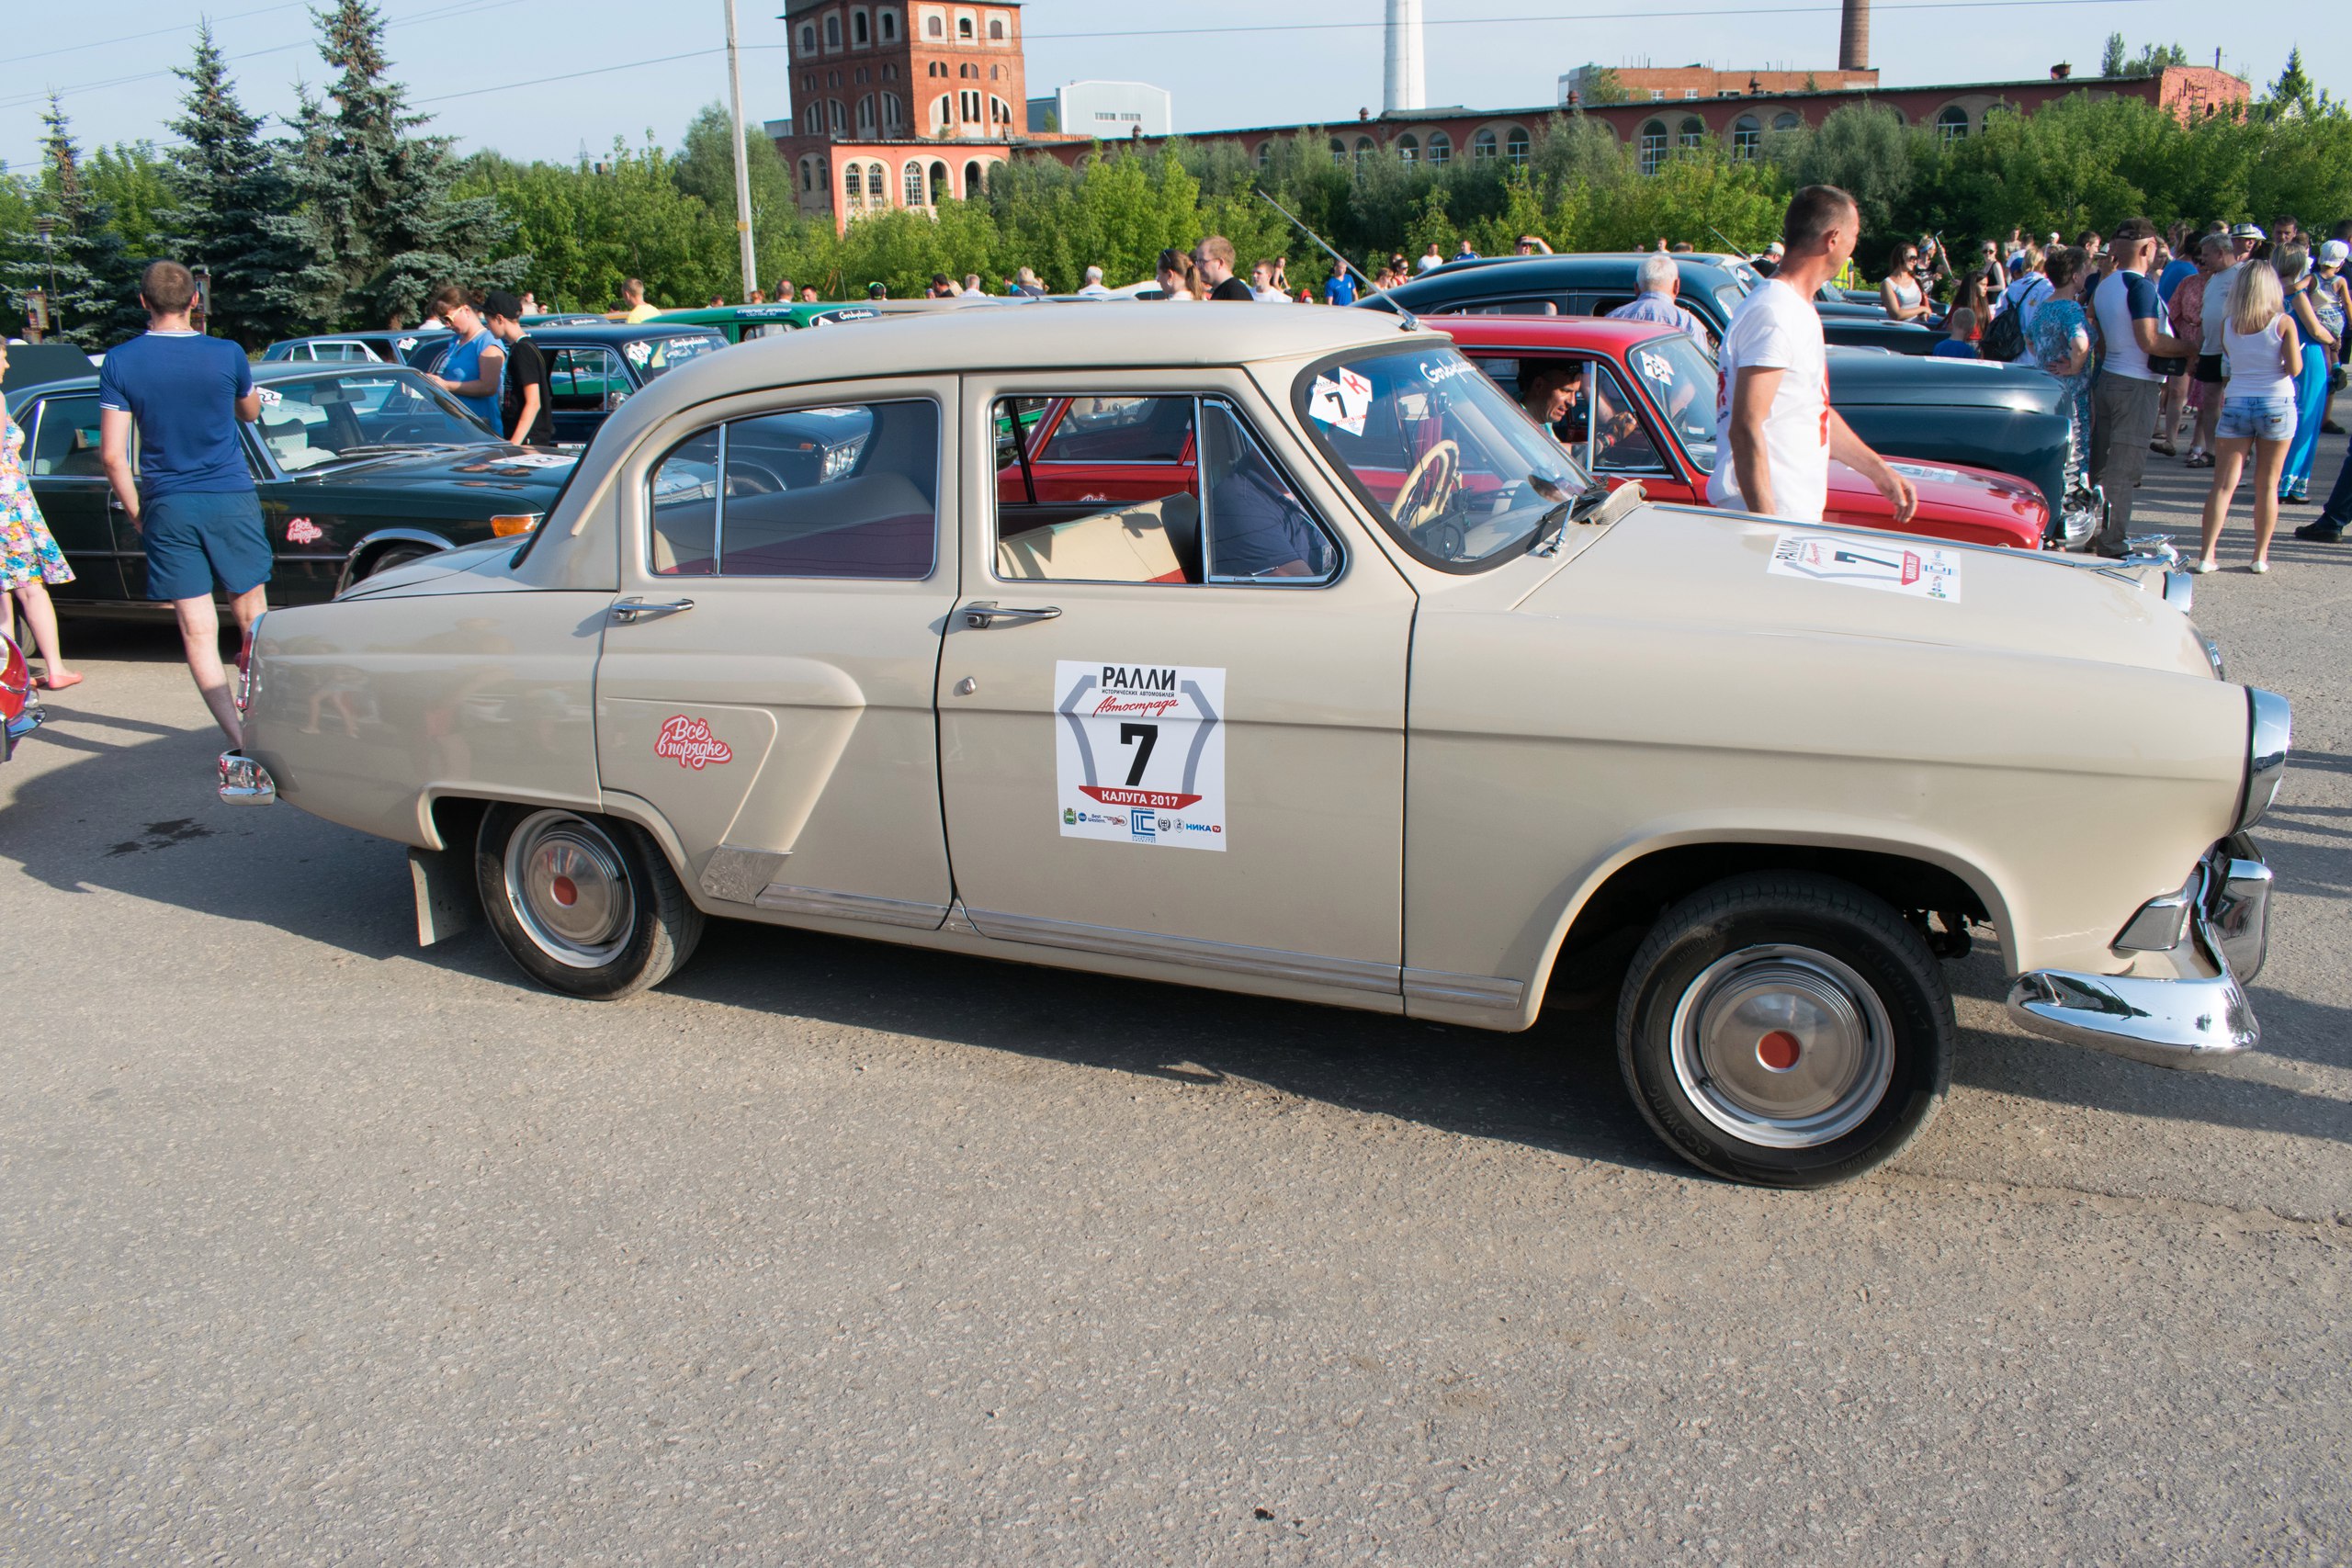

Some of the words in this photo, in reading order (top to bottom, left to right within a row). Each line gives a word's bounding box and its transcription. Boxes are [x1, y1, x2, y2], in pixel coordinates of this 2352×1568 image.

[1324, 391, 1348, 419] 7
[1834, 551, 1899, 569] 7
[1102, 666, 1176, 691] РАЛЛИ
[1102, 688, 1138, 696] ИСТОРИЧЕСКИХ
[1092, 695, 1179, 717] Автострада
[664, 716, 710, 741] Всё
[667, 738, 731, 768] порядке
[1121, 722, 1158, 786] 7
[1102, 790, 1148, 804] КАЛУГА
[1150, 794, 1179, 807] 2017
[1185, 823, 1212, 832] НИКА
